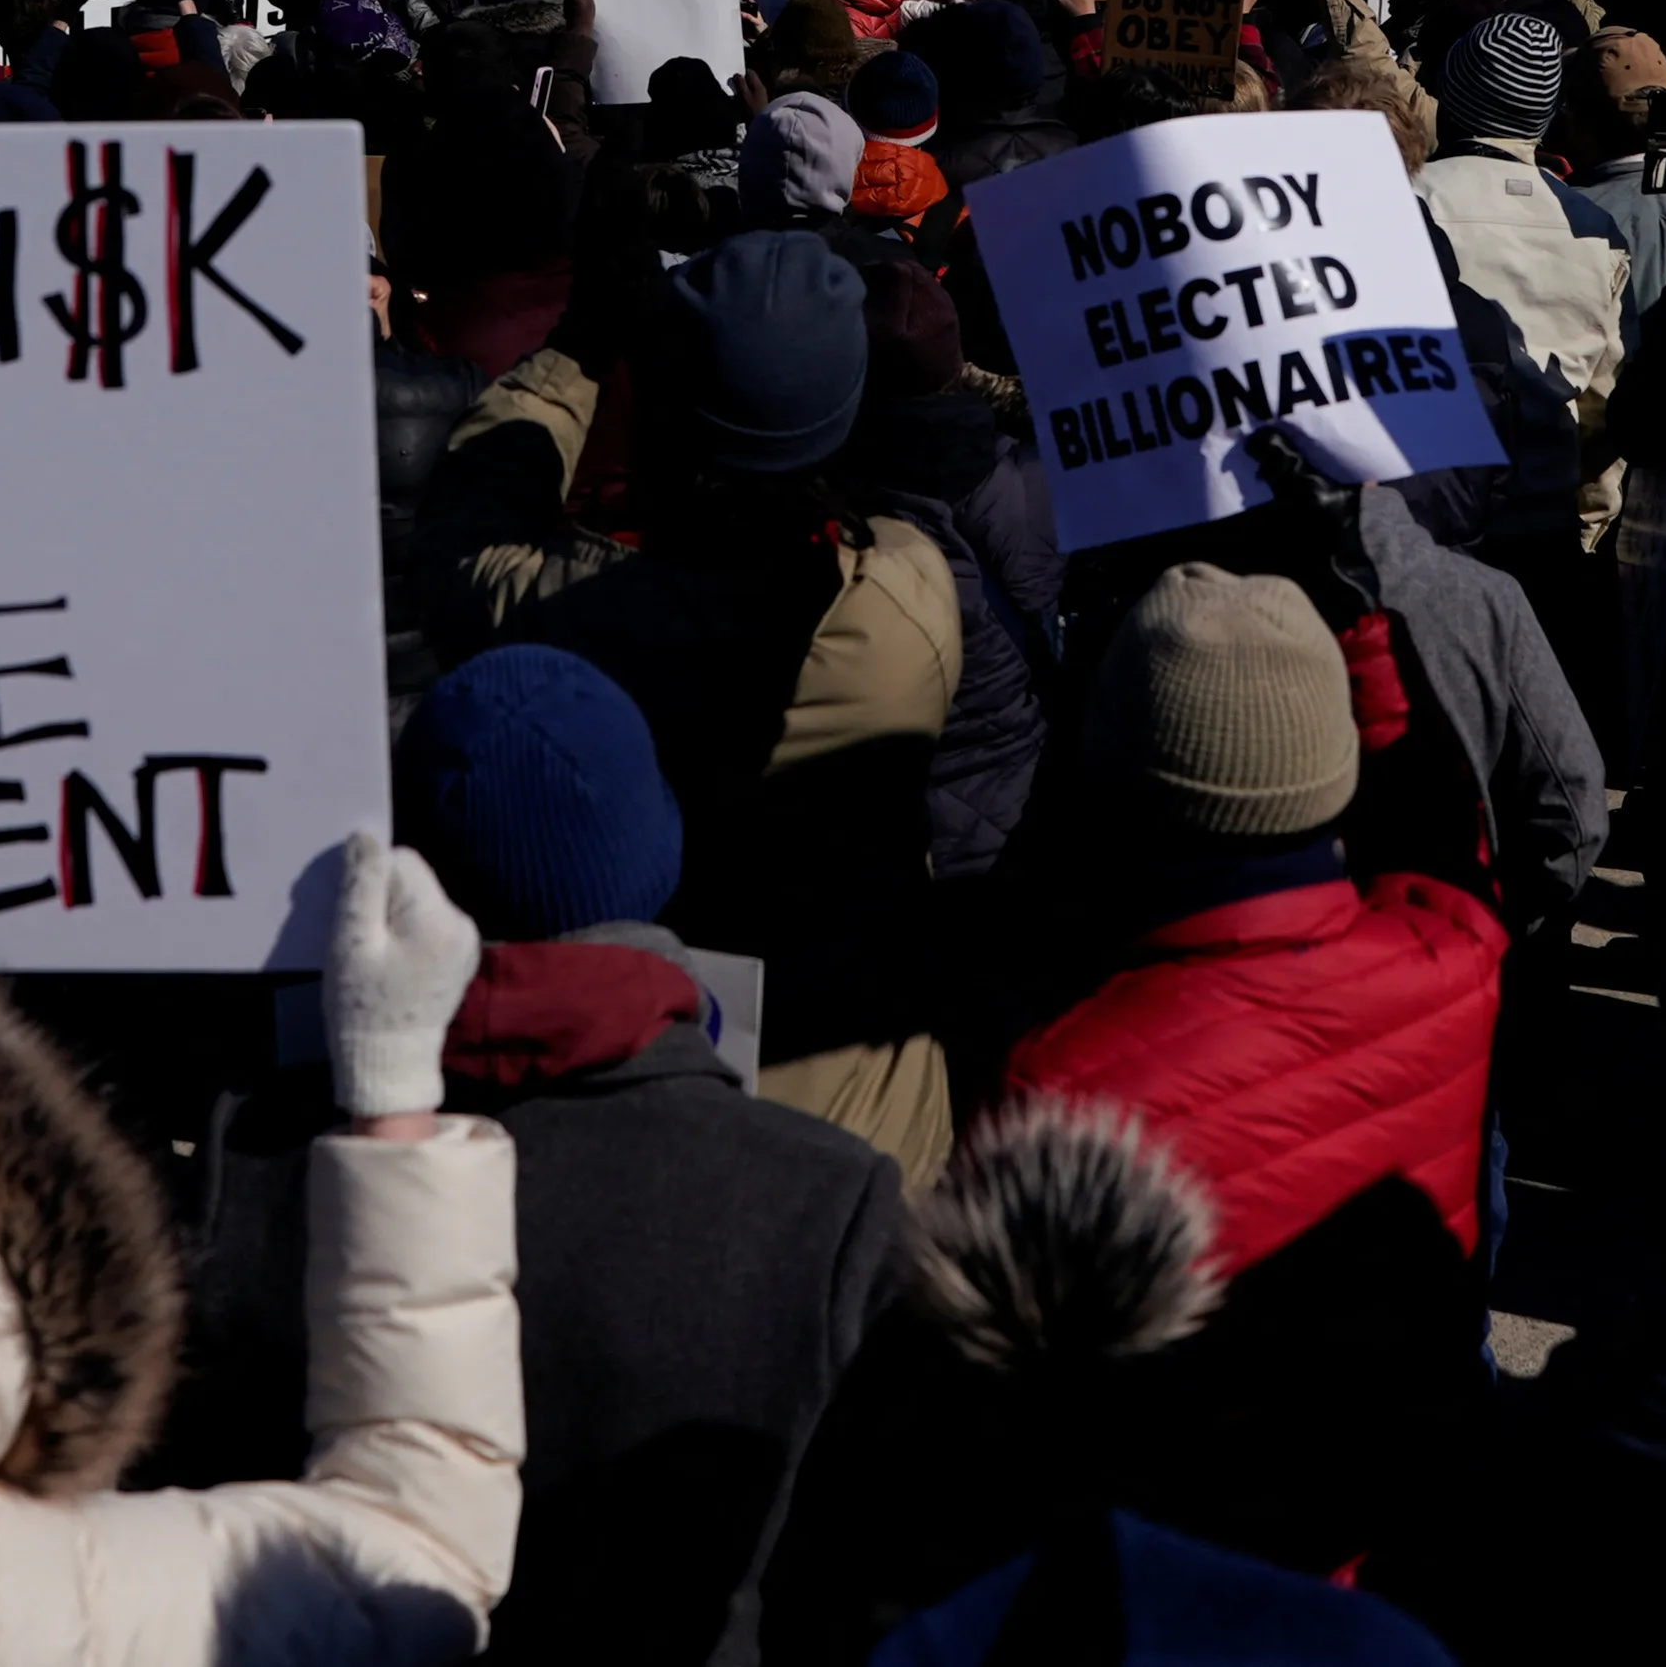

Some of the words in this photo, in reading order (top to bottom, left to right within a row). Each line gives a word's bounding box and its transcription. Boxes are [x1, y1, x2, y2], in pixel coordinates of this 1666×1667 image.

[1117, 14, 1233, 55] OBEY
[1061, 173, 1323, 281] NOBODY
[1085, 257, 1358, 367] ELECTED
[1050, 336, 1457, 471] BILLIONAIRES
